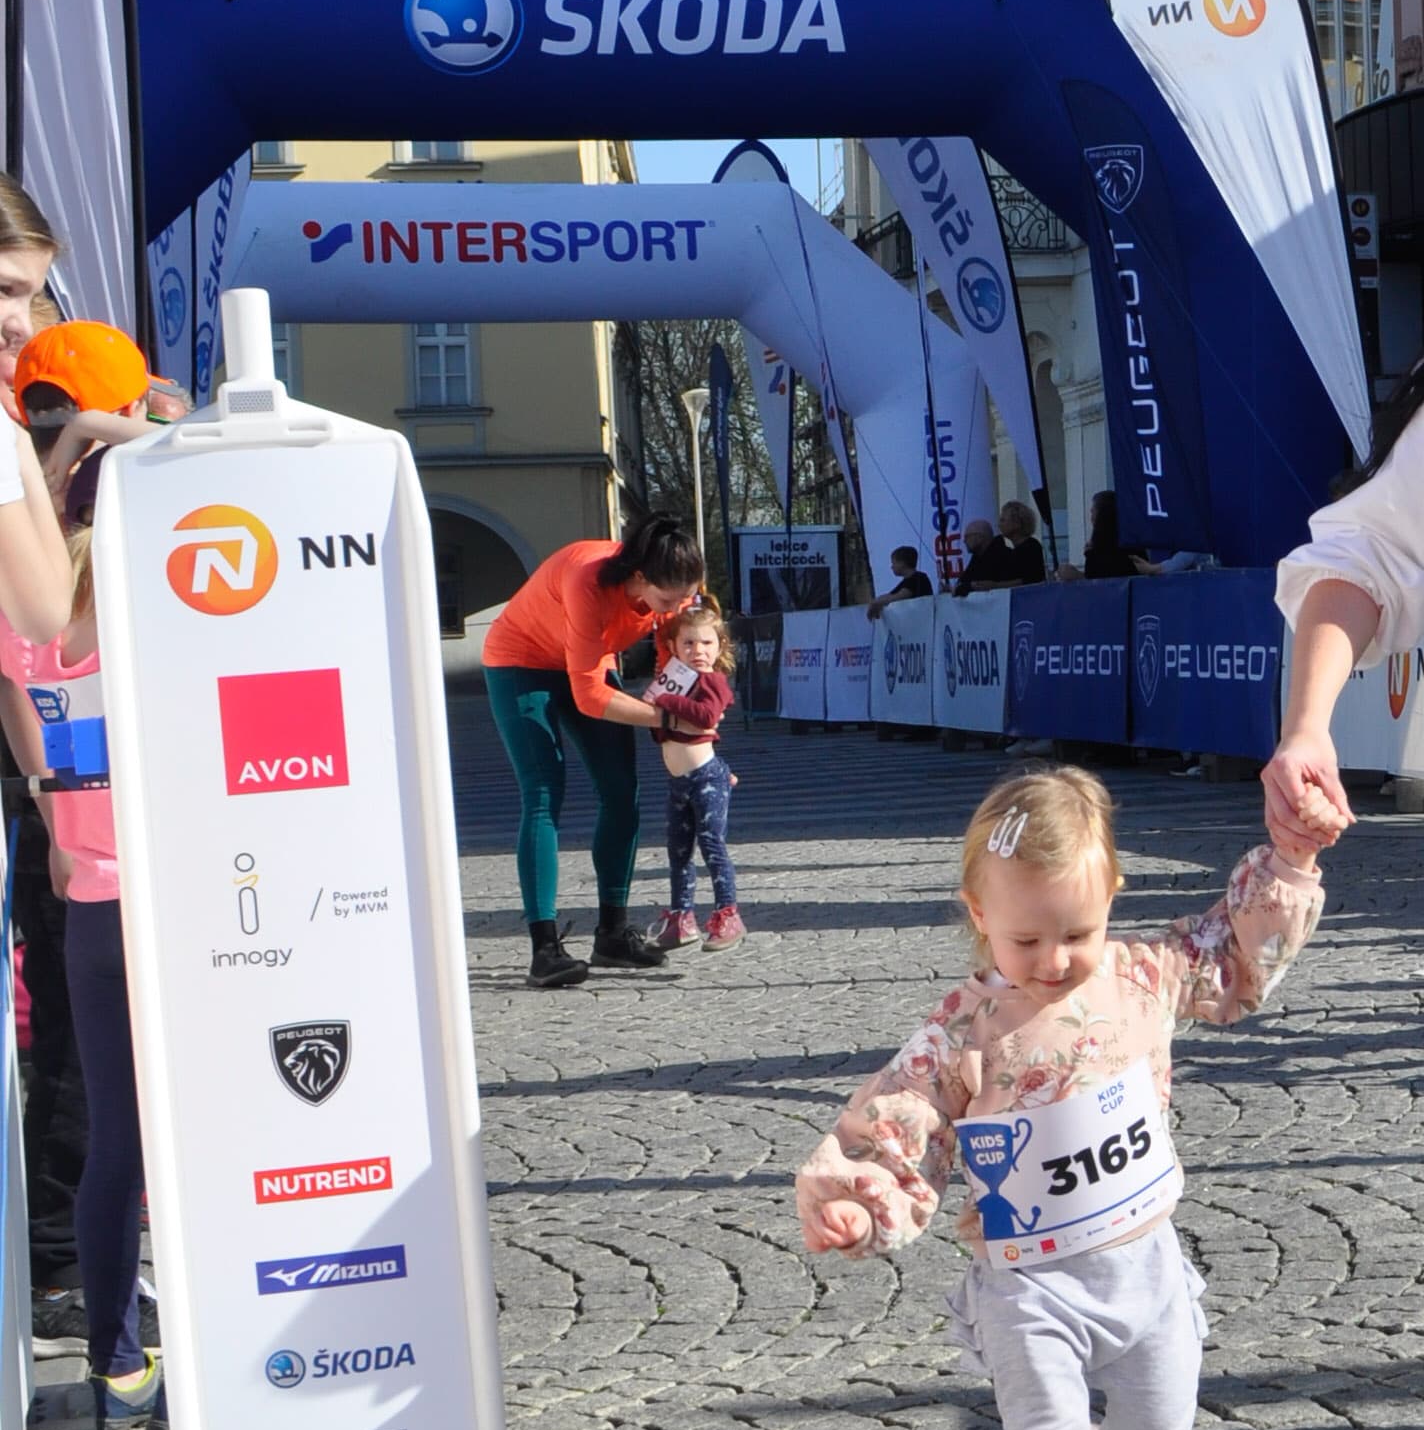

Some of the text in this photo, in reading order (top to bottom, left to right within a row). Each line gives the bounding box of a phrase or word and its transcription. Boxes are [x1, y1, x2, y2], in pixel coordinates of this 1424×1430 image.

[362, 220, 706, 264] INTERSPORT
[924, 413, 965, 579] ERSPORT
[300, 533, 376, 571] NN
[957, 630, 1000, 687] ŠKODA
[1034, 644, 1124, 676] PEUGEOT
[238, 754, 334, 785] AVON
[332, 887, 388, 902] Powered
[334, 901, 388, 918] by MVM
[211, 945, 292, 969] innogy
[276, 1026, 344, 1042] PEUGEOT
[1097, 1081, 1124, 1103] KIDS
[1101, 1096, 1124, 1114] CUP
[970, 1134, 1005, 1149] KIDS
[1042, 1117, 1151, 1196] 3165
[976, 1151, 1005, 1165] CUP
[261, 1161, 387, 1197] NUTREND
[311, 1341, 417, 1379] ŠKODA
